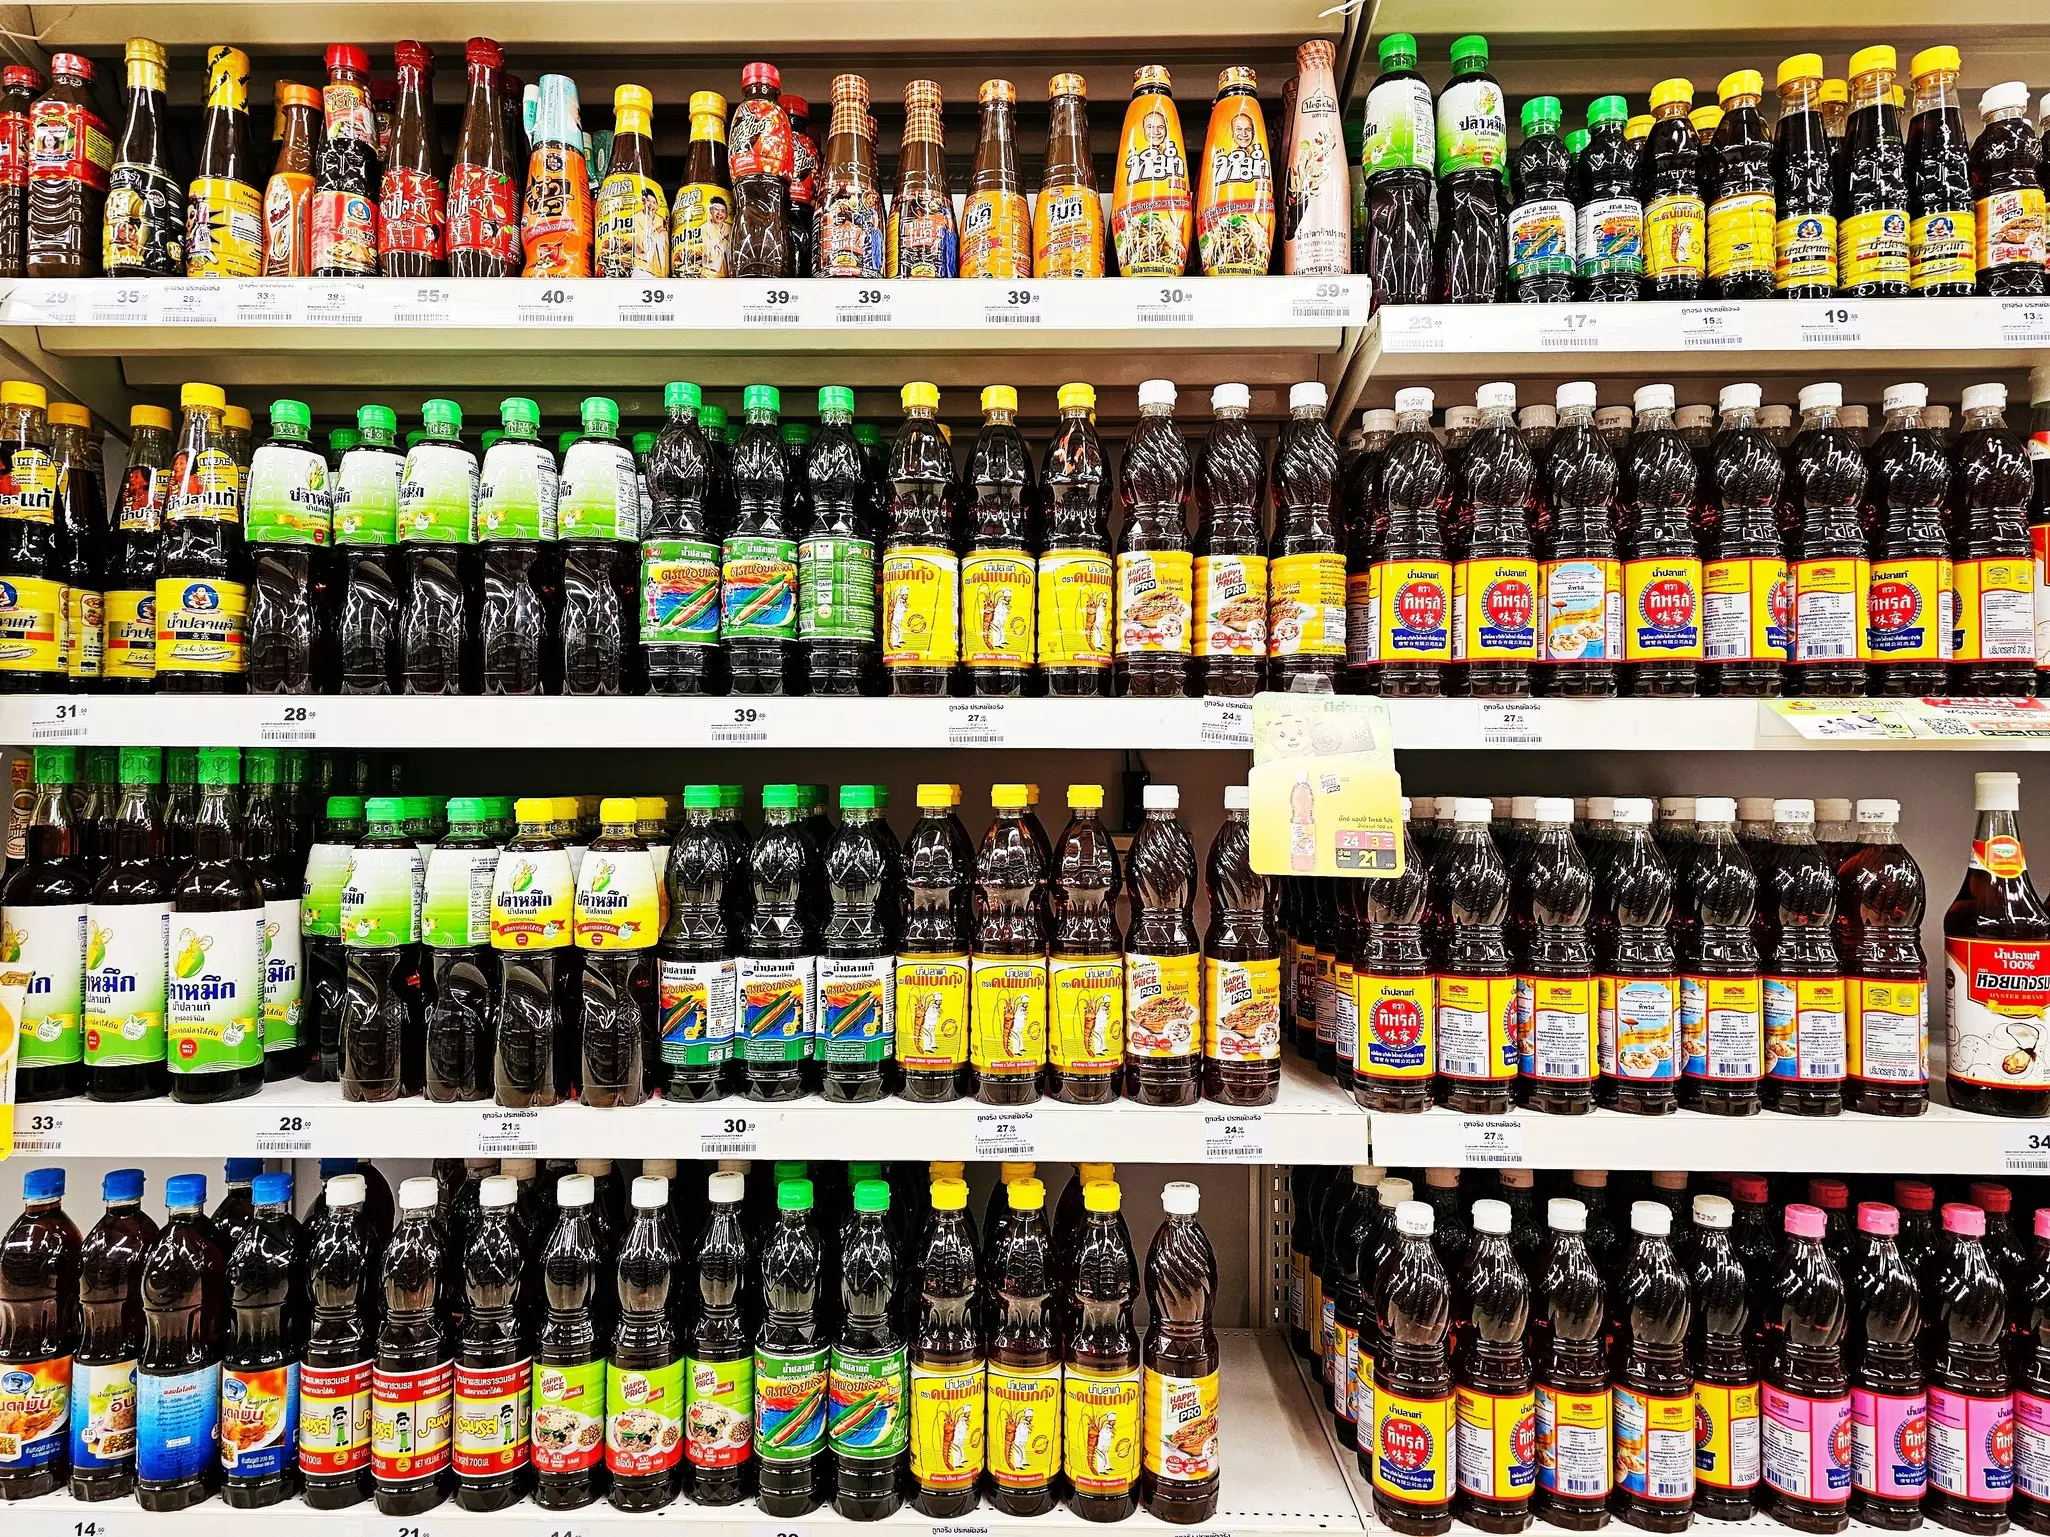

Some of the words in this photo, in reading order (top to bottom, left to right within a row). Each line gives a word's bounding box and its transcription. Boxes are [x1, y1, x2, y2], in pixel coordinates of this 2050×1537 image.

[681, 545, 713, 560] น้ำปลาแท้
[1128, 571, 1153, 586] PRICE
[1407, 567, 1440, 580] น้ำปลาแท้
[1494, 566, 1527, 578] น้ำปลาแท้
[1652, 566, 1687, 578] น้ำปลาแท้
[1134, 580, 1155, 595] PRO
[1216, 575, 1243, 589] PRICE
[1225, 584, 1247, 598] PRO
[1404, 593, 1441, 609] ทิพรส
[1492, 591, 1529, 608] ทิพรส
[1650, 590, 1689, 608] ทิพรส
[167, 612, 235, 631] น้ำปลาแท้
[1342, 835, 1359, 847] 24
[1371, 836, 1380, 848] 3
[1358, 850, 1378, 868] 21
[497, 888, 553, 908] ปลาหมึก
[577, 889, 629, 908] ปลาหมึก
[507, 907, 538, 915] น้ำปลาแท้
[1993, 946, 2041, 961] น้ำปลาแท้
[753, 960, 795, 972] น้ำปลาแท้
[833, 960, 875, 972] น้ำปลาแท้
[2001, 959, 2036, 971] 100%
[1134, 975, 1157, 989] PRICE
[1223, 973, 1246, 988] HAPPY
[1224, 980, 1247, 994] PRICE
[1141, 985, 1161, 998] PRO
[1232, 990, 1252, 1003] PRO
[1381, 984, 1415, 996] น้ำปลาแท้
[1989, 992, 2020, 1000] OYSTER
[2021, 992, 2044, 1000] BRAND
[1379, 1008, 1417, 1026] ทิพรส
[1897, 1068, 1908, 1078] 700
[782, 1360, 816, 1373] น้ำปลาแท้
[541, 1374, 563, 1387] HAPPY
[694, 1370, 715, 1383] HAPPY
[542, 1382, 565, 1394] PRICE
[623, 1379, 648, 1392] HAPPY
[695, 1378, 716, 1390] PRICE
[624, 1386, 648, 1399] PRICE
[1169, 1390, 1196, 1405] HAPPY
[1171, 1398, 1197, 1413] PRICE
[1389, 1404, 1422, 1419] น้ำปลาแท้
[1180, 1408, 1201, 1422] PRO
[1387, 1426, 1424, 1450] ทิพรส
